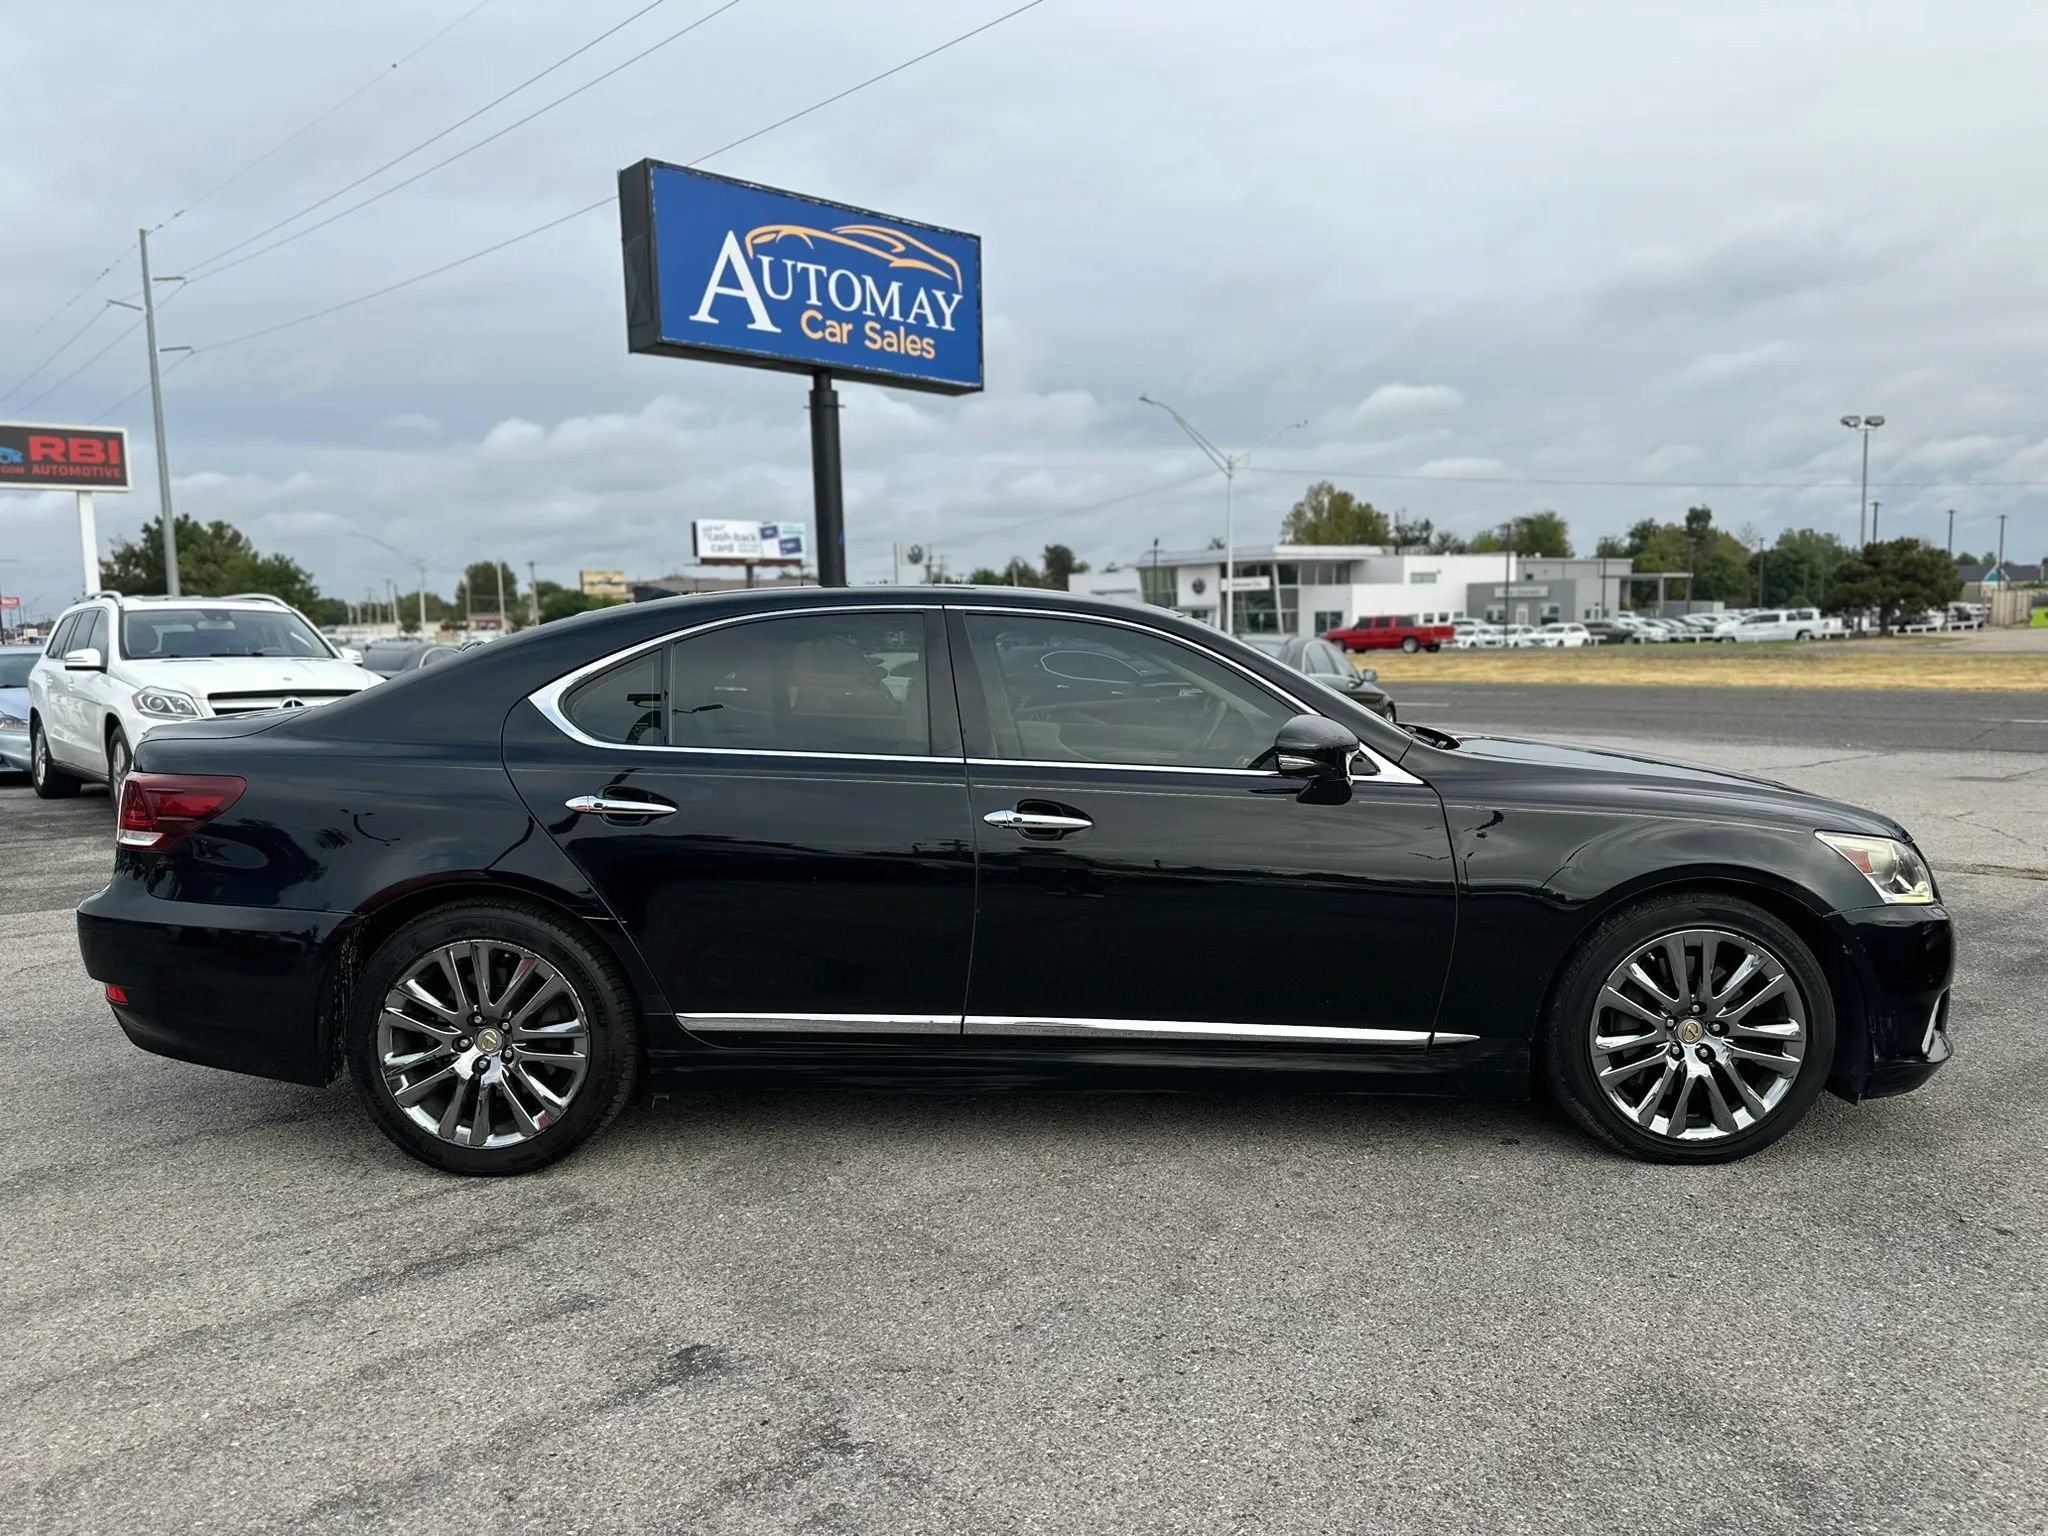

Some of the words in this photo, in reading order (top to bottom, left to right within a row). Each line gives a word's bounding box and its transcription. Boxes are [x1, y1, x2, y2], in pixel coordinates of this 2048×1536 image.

[689, 229, 963, 333] AUTOMAY
[800, 309, 852, 346] Car
[864, 320, 936, 360] Sales
[28, 434, 120, 465] RBI
[32, 464, 121, 478] AUTOMOTIVE
[710, 542, 735, 553] card
